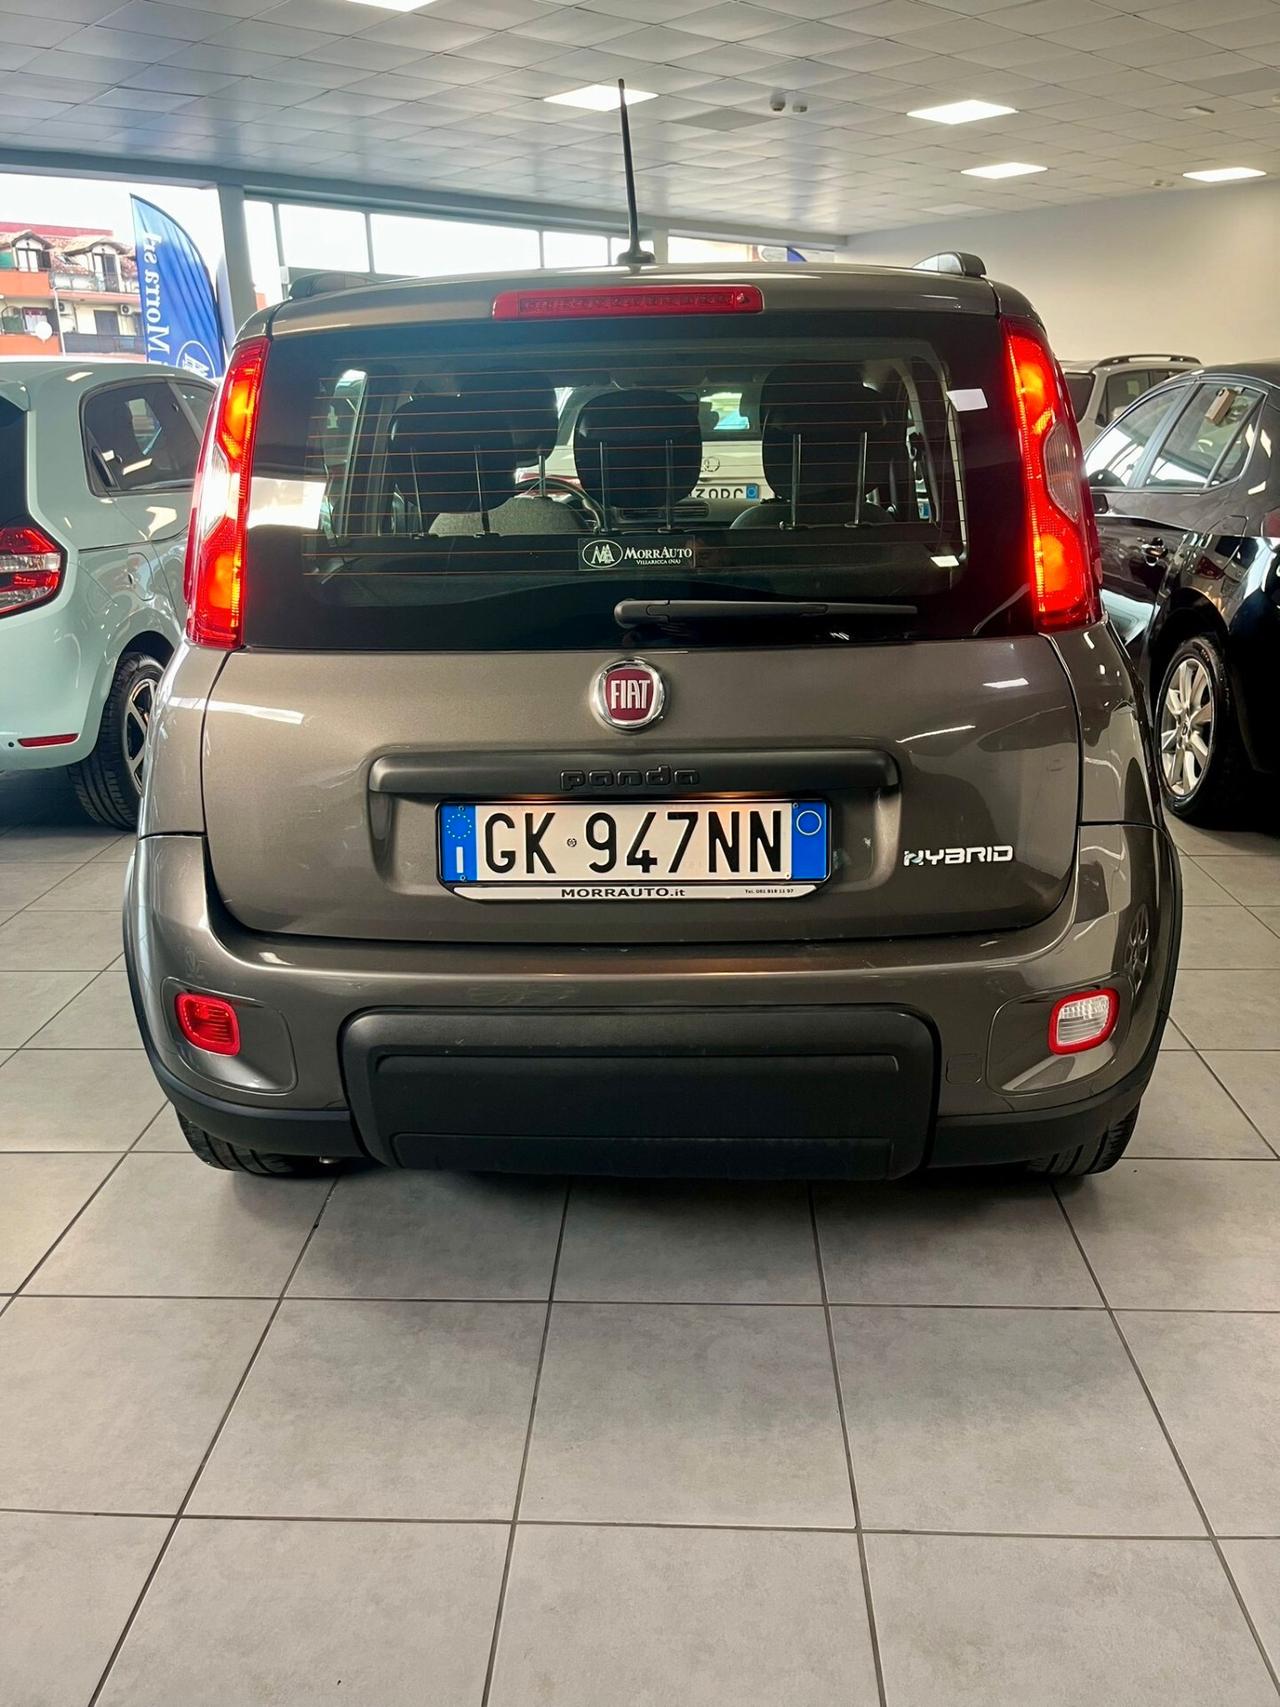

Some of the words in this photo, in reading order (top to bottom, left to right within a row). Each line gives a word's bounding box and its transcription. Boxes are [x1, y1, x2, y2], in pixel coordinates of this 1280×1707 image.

[610, 680, 651, 710] FIAT
[561, 766, 699, 791] panda
[485, 812, 557, 874] GK
[585, 810, 783, 874] 947NN
[903, 845, 1013, 867] HYBRID
[561, 888, 686, 898] MORRAUTO.it
